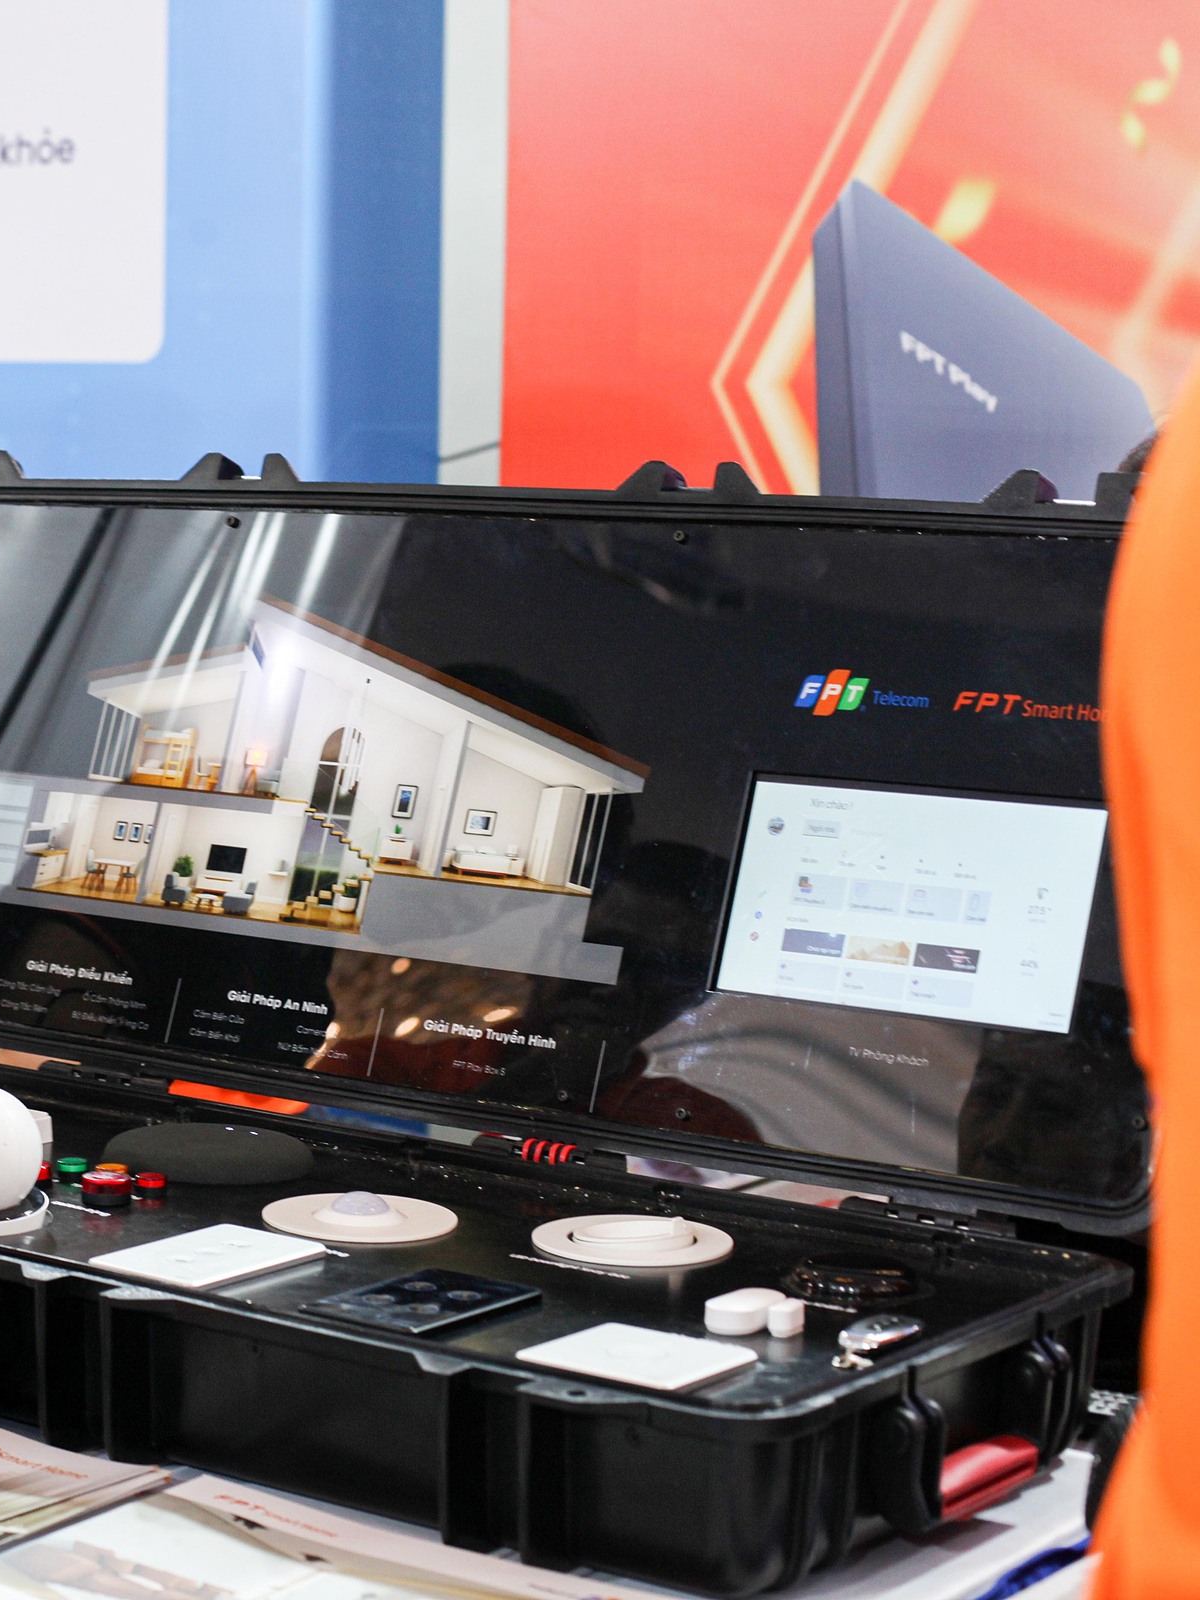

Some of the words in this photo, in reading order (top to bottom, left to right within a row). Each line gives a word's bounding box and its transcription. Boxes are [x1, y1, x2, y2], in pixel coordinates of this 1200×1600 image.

[0, 127, 76, 165] khỏe
[900, 330, 947, 376] FPT
[873, 690, 929, 708] Telecom
[953, 691, 1022, 715] FPT
[1021, 700, 1074, 720] Smart
[1076, 703, 1101, 722] Ho
[26, 960, 48, 973] Giải
[49, 963, 76, 979] Pháp
[103, 971, 133, 986] Khiển
[227, 990, 251, 1003] Giải
[252, 994, 282, 1010] Pháp
[284, 999, 300, 1011] An
[301, 1001, 328, 1015] Ninh
[423, 1019, 449, 1033] Giải
[451, 1022, 483, 1040] Pháp
[485, 1028, 525, 1045] Truyền
[528, 1034, 557, 1050] Hình
